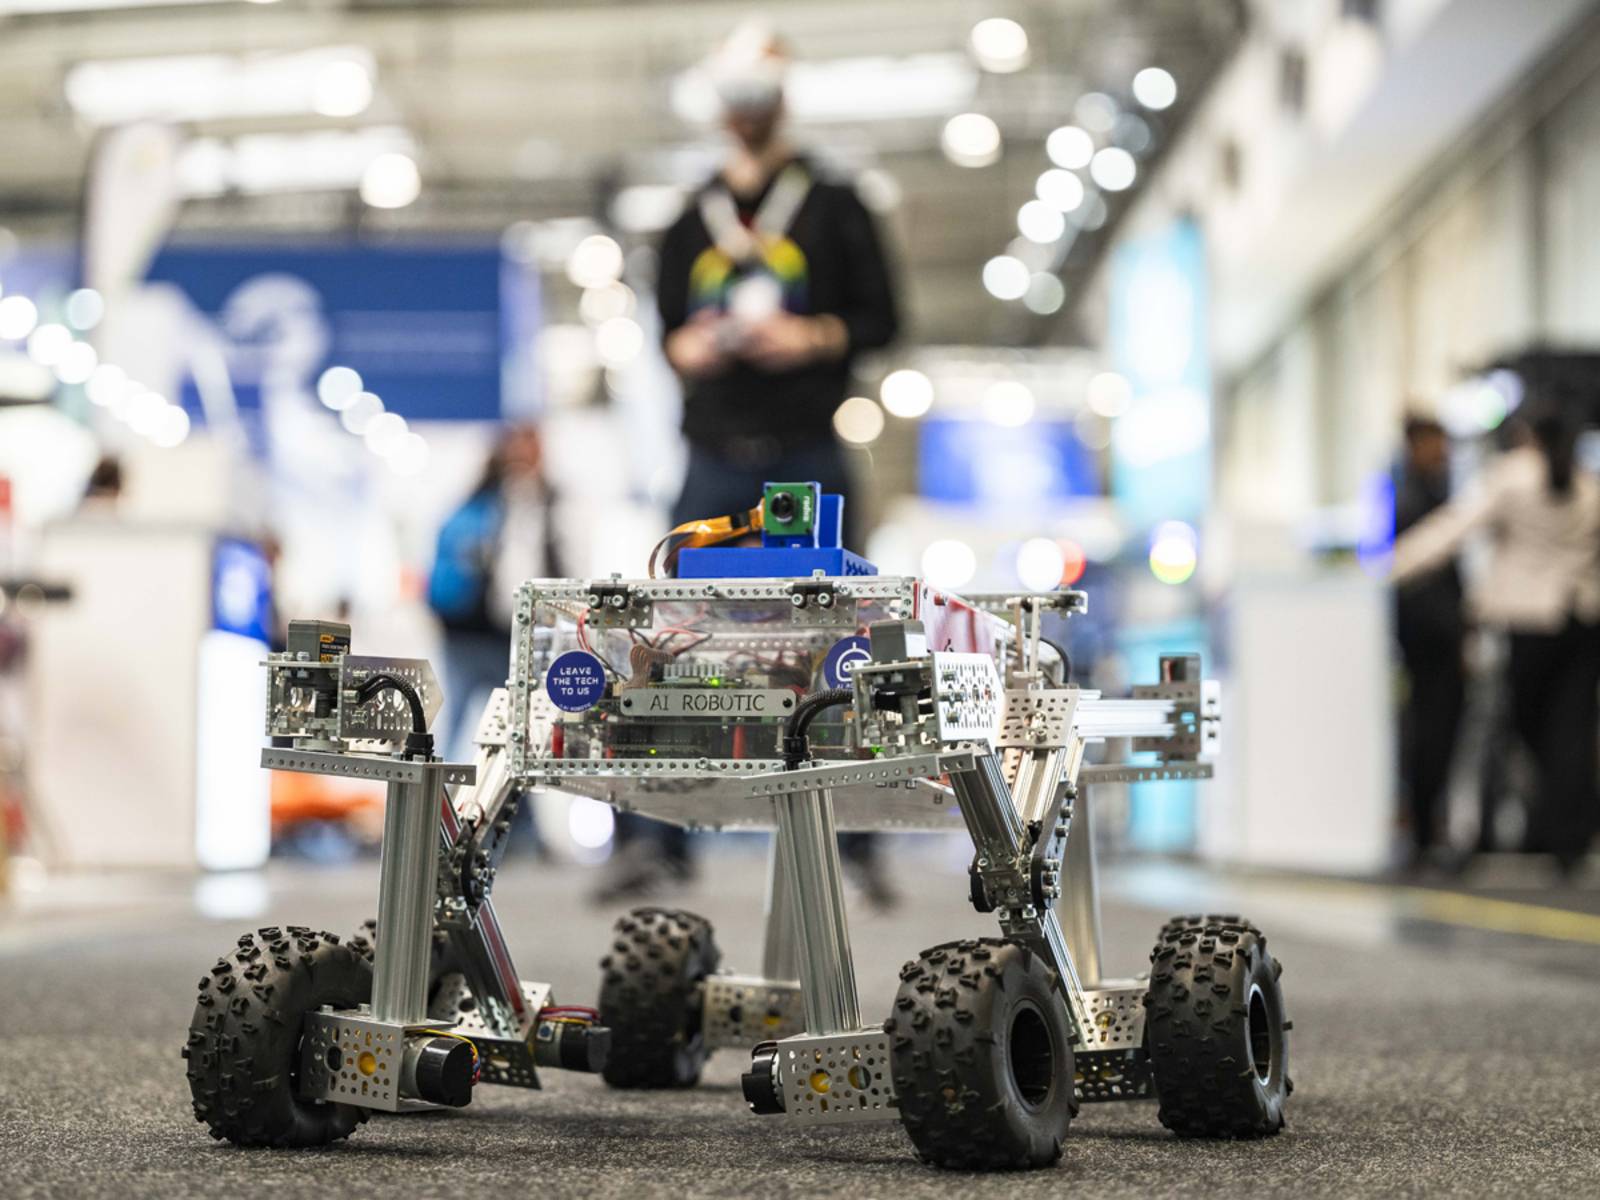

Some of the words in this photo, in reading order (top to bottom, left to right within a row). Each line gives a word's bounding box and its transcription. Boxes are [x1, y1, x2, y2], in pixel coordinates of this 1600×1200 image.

[560, 667, 592, 675] LEAVE
[553, 677, 571, 686] THE
[574, 677, 599, 685] TECH
[561, 687, 574, 695] TO
[577, 687, 590, 695] US
[650, 694, 669, 711] AI
[682, 694, 766, 711] ROBOTIC
